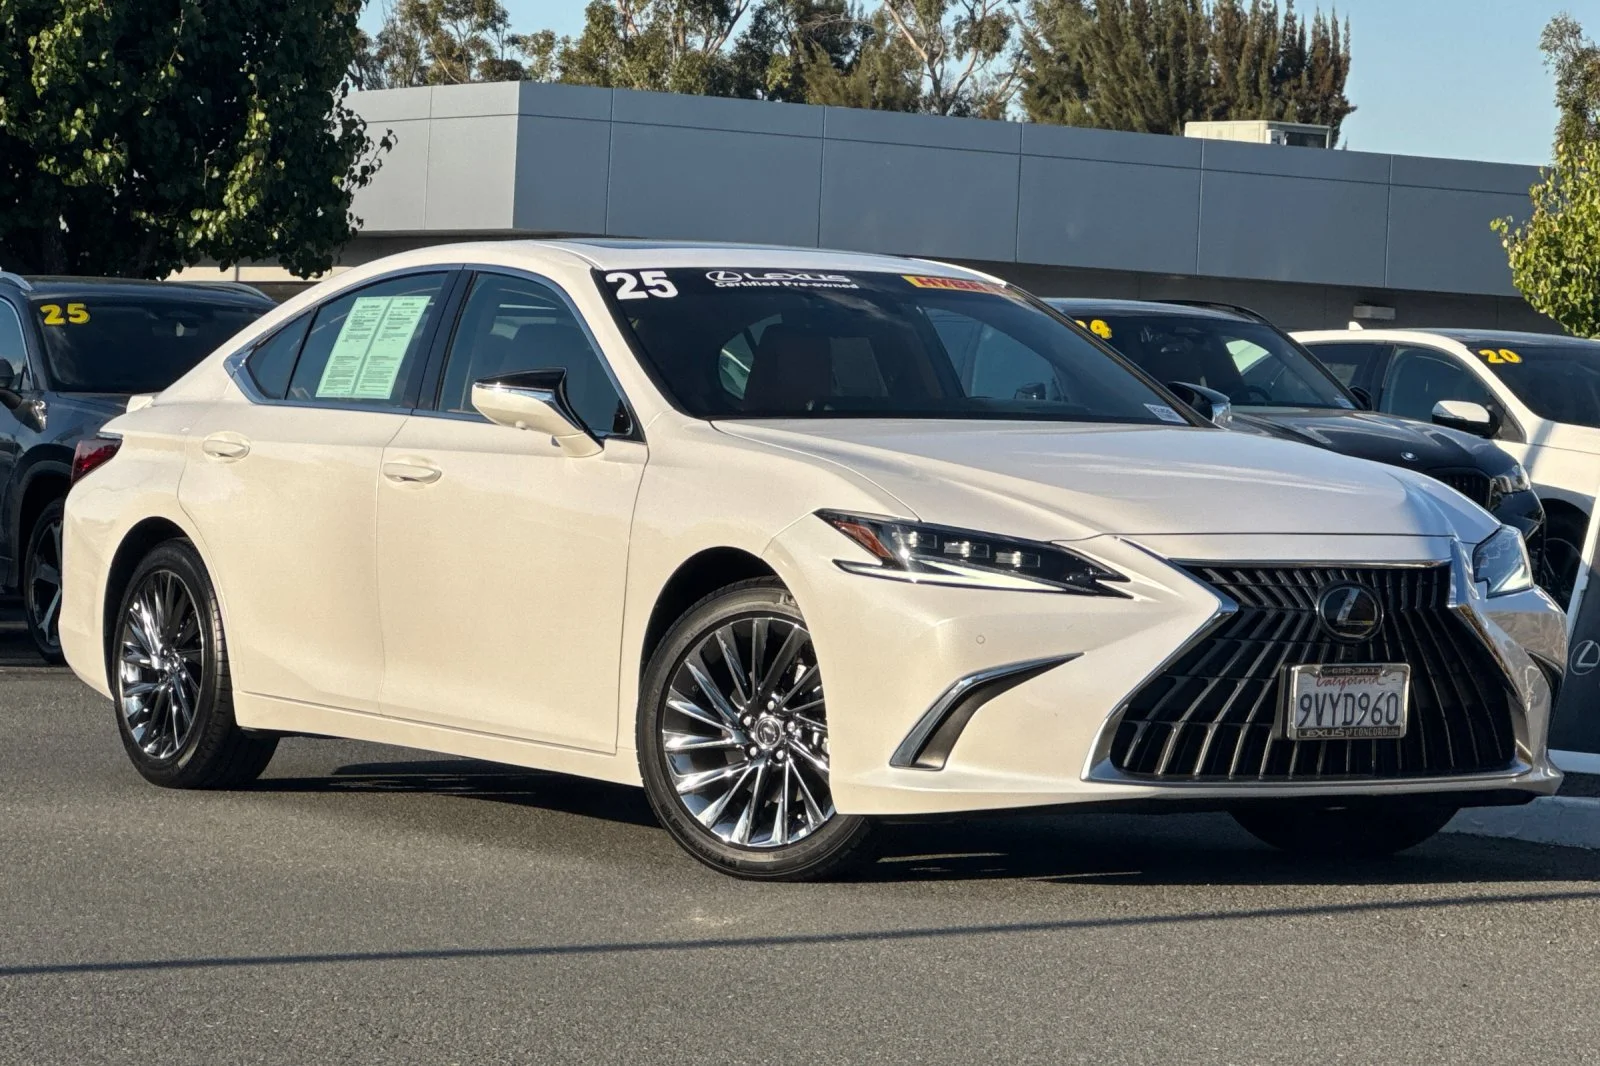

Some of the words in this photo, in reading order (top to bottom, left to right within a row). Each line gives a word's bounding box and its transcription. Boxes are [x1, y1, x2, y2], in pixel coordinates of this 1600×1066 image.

[743, 272, 851, 283] LEXUS
[605, 270, 679, 300] 25
[782, 281, 859, 289] Pre-owned
[40, 303, 90, 325] 25
[1478, 349, 1522, 363] 20
[1316, 675, 1386, 690] California
[1298, 692, 1399, 727] 9VYD960
[1299, 730, 1345, 738] LEXUS
